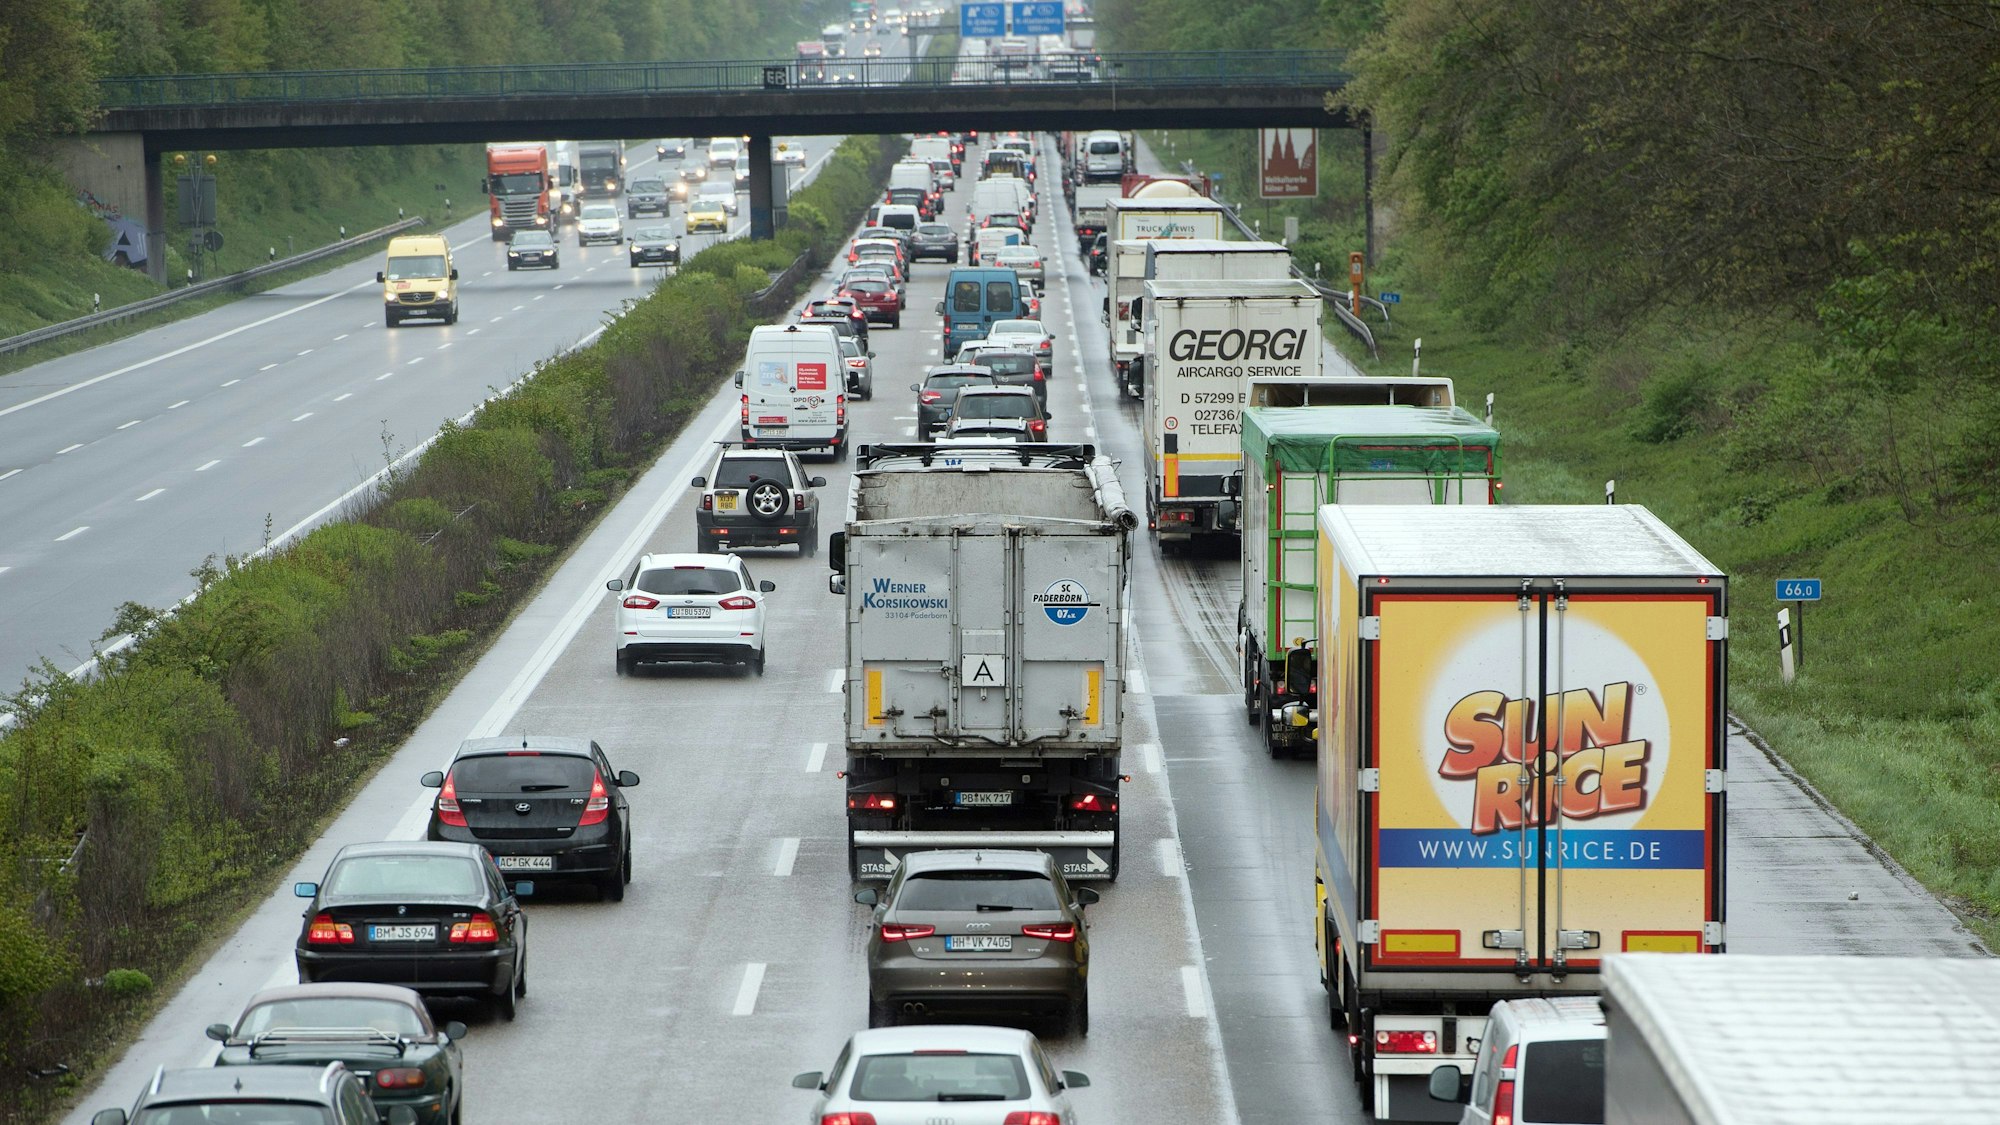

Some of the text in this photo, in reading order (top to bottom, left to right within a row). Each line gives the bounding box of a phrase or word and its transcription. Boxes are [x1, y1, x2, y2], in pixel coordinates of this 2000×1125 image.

[1136, 225, 1163, 233] TRUCK
[1169, 328, 1307, 361] GEORGI
[1177, 366, 1301, 378] AIRCARGO SERVICE
[1181, 393, 1190, 404] D
[1194, 393, 1235, 404] 57299
[873, 578, 926, 593] WERNER
[1061, 584, 1071, 592] SC
[1785, 583, 1812, 596] 66.0
[864, 592, 948, 608] KORSIKOWSKI
[1033, 594, 1082, 602] PADERBORN
[973, 660, 994, 681] A
[1438, 681, 1630, 779] SUN
[962, 794, 973, 803] PB
[993, 794, 1011, 803] 717
[1418, 841, 1661, 860] WWW.SUNRICE.DE
[500, 857, 512, 867] AC
[533, 857, 550, 867] 444
[861, 863, 885, 873] STAS
[1063, 863, 1087, 873] STAS
[376, 927, 391, 938] BM
[414, 927, 434, 938] 694
[952, 936, 965, 948] HH
[987, 936, 1011, 948] 7405
